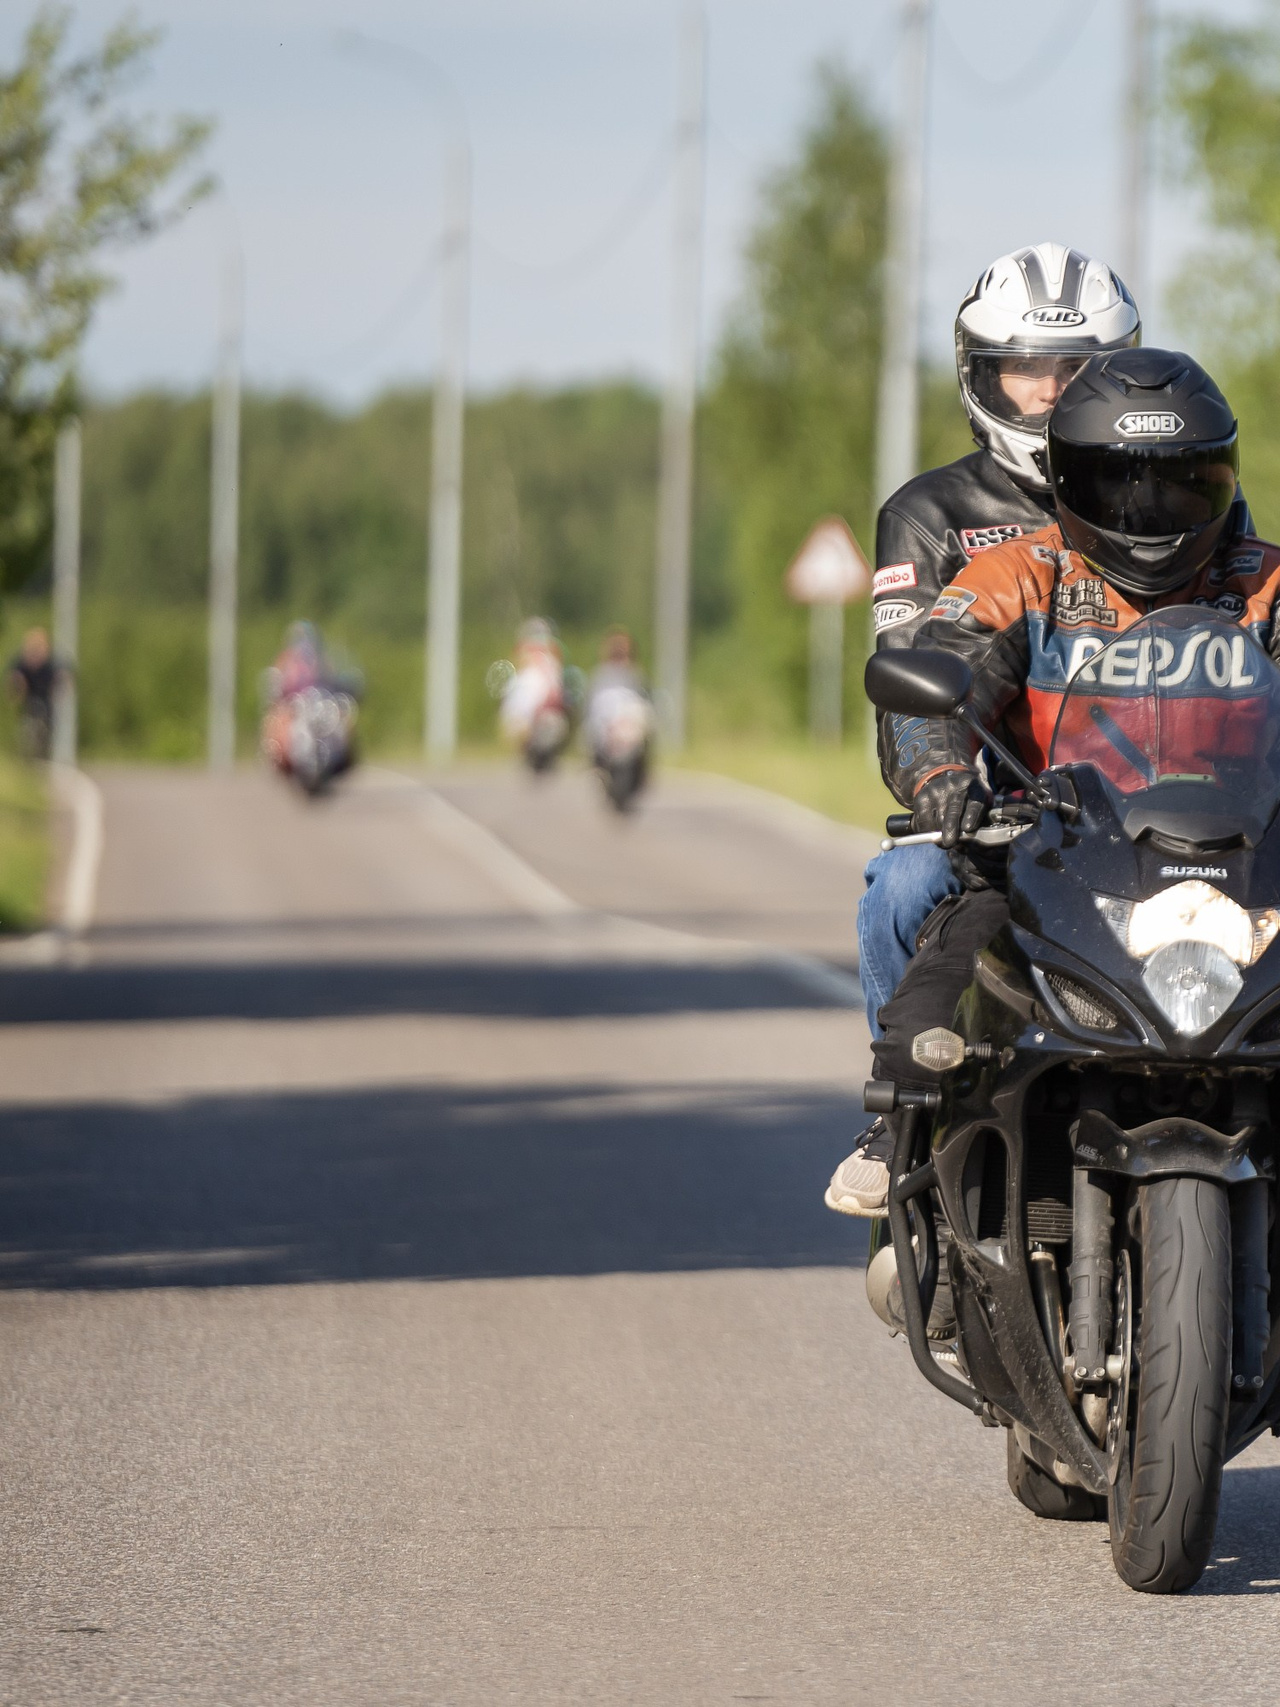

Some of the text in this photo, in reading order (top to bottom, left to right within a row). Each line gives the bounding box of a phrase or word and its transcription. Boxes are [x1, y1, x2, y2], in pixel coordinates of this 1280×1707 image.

[1032, 311, 1080, 323] HJC
[1123, 415, 1176, 433] SHOEI
[1067, 630, 1254, 687] REPSOL
[1160, 866, 1228, 879] SUZUKI
[1076, 1144, 1098, 1158] ABS
